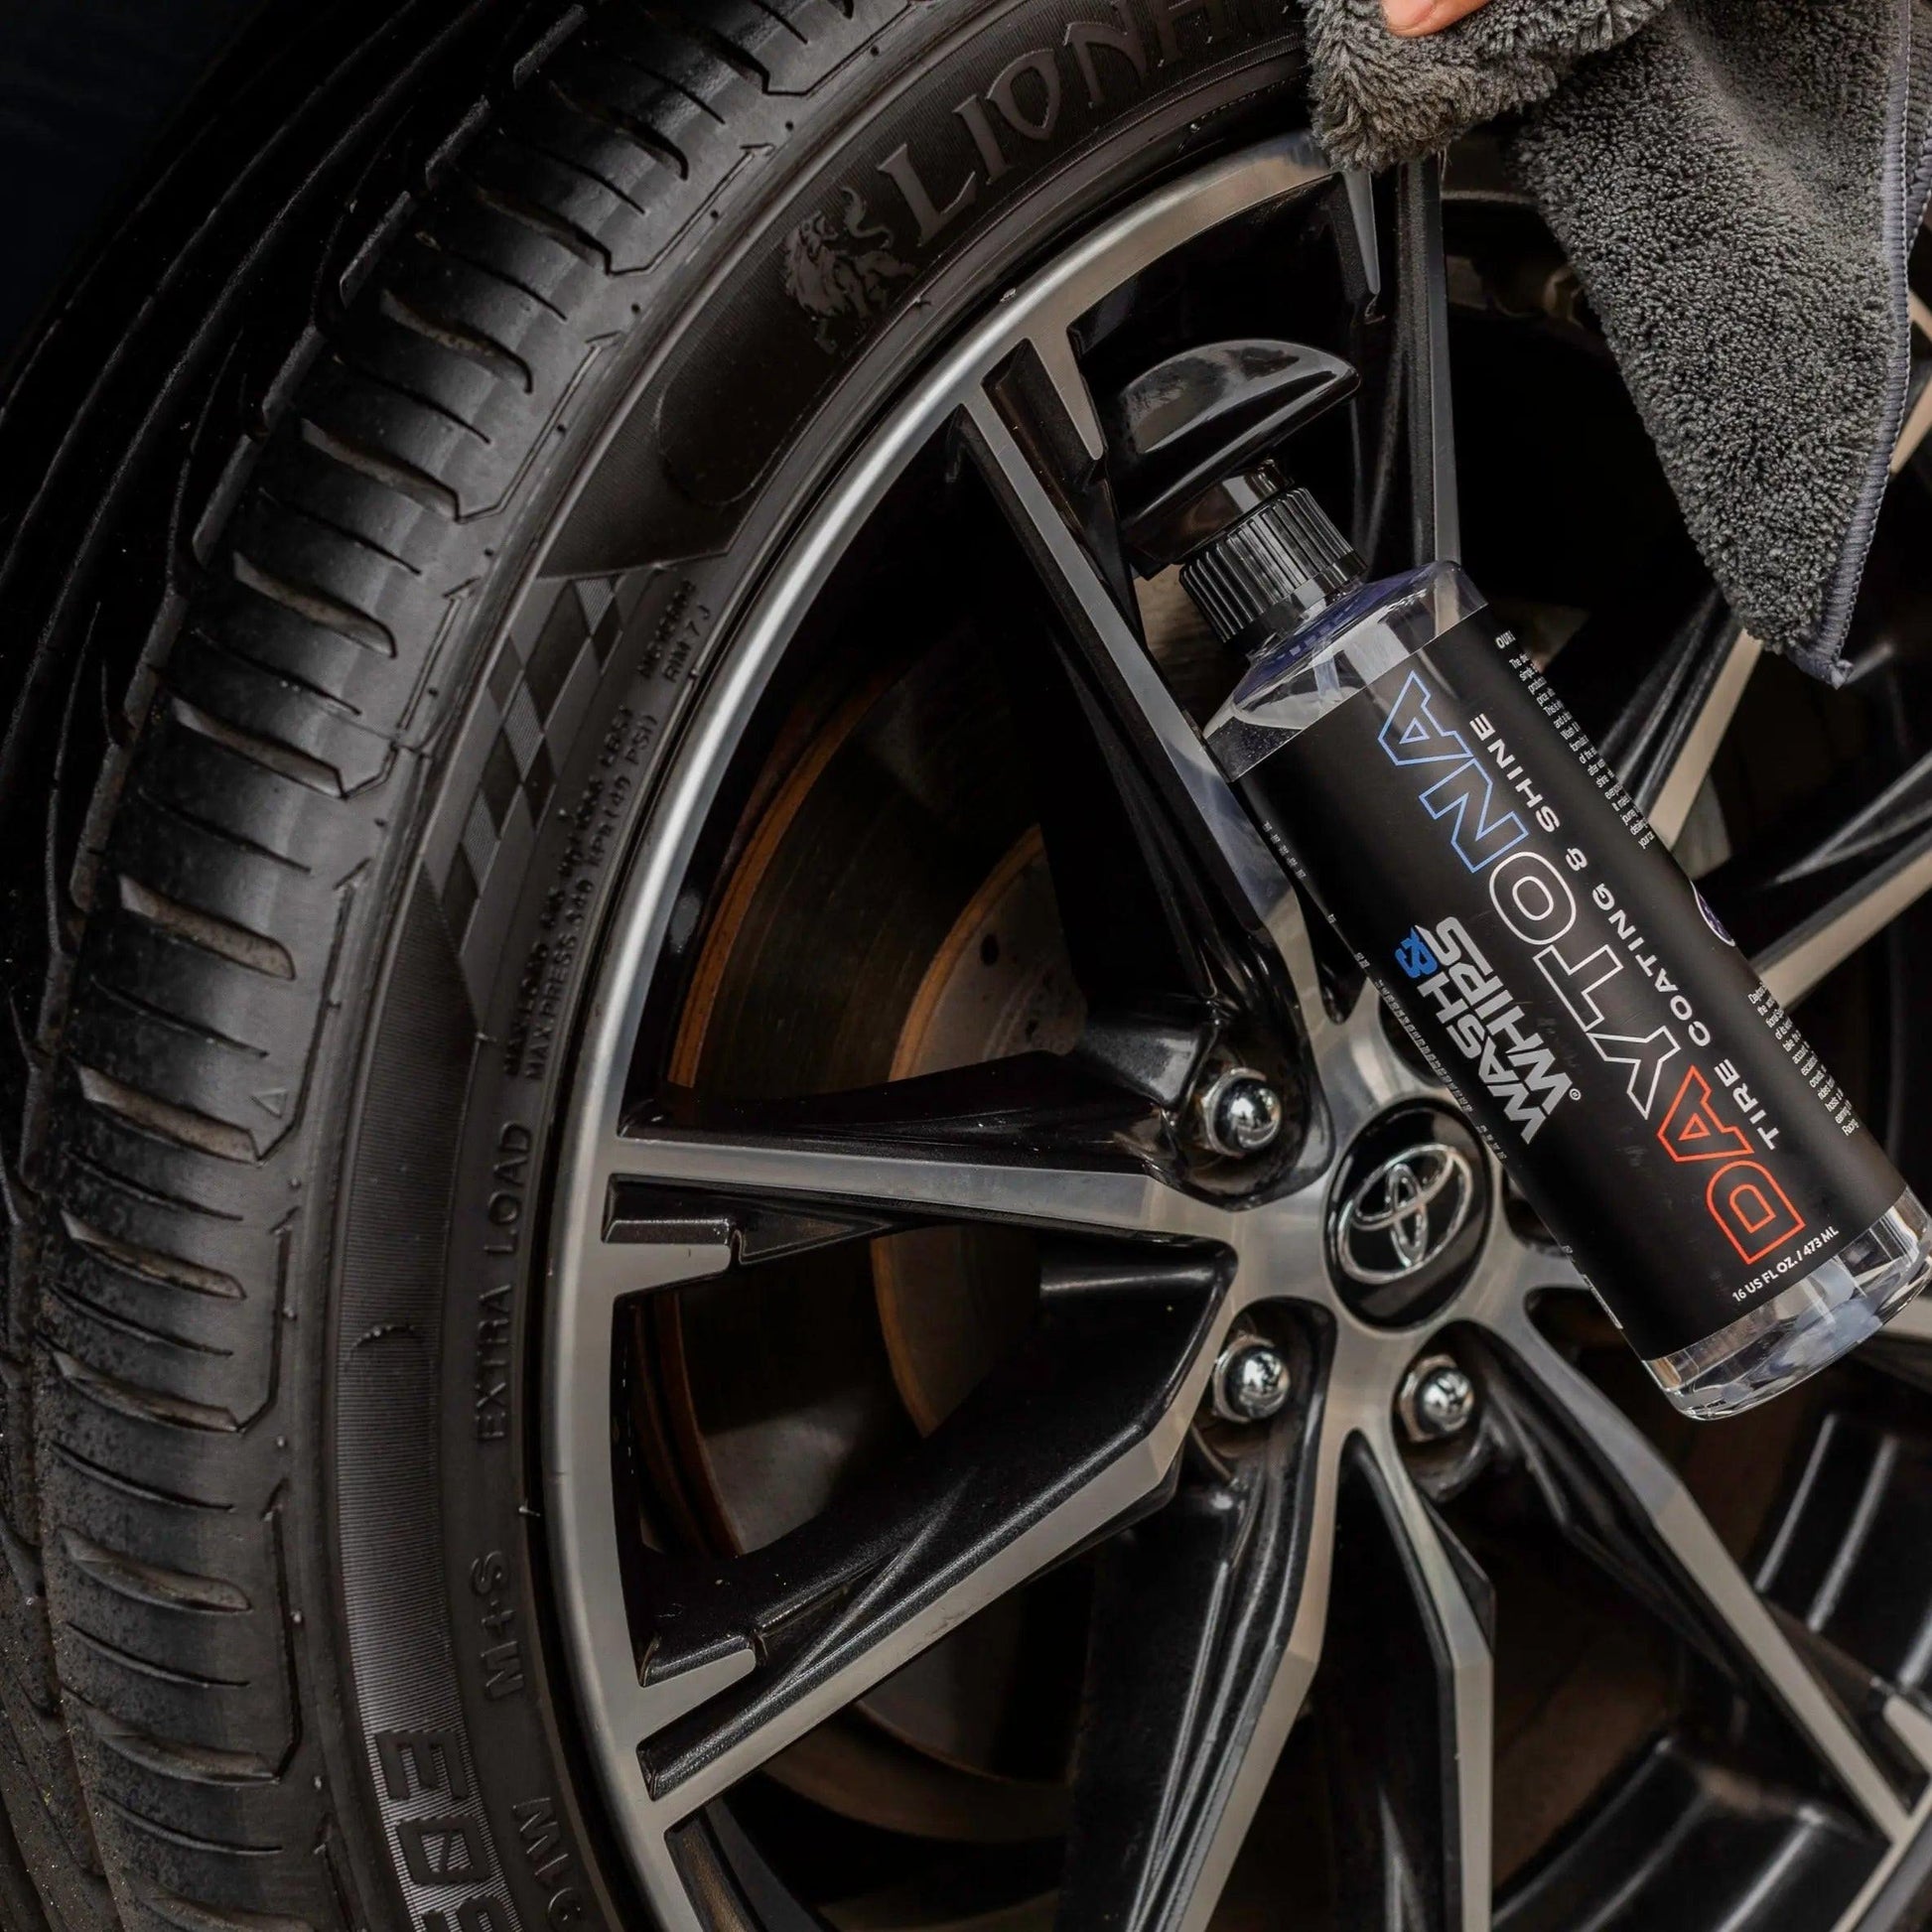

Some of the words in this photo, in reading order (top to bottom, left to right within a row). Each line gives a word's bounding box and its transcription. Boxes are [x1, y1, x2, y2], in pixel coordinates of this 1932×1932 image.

[1469, 713, 1562, 834] SHINE
[1565, 847, 1588, 872] &
[1377, 669, 1806, 1265] DAYTONA
[1591, 881, 1713, 1047] COATING
[1715, 1060, 1779, 1152] TIRE
[483, 1120, 533, 1255] LOAD
[1731, 1289, 1747, 1303] 16
[1744, 1278, 1763, 1294] US
[1760, 1269, 1779, 1285] FL
[1775, 1256, 1799, 1274] OZ.
[1796, 1250, 1804, 1262] /
[1803, 1237, 1824, 1256] 473
[1820, 1225, 1840, 1243] ML
[475, 1284, 512, 1440] EXTRA
[471, 1550, 525, 1702] M+S
